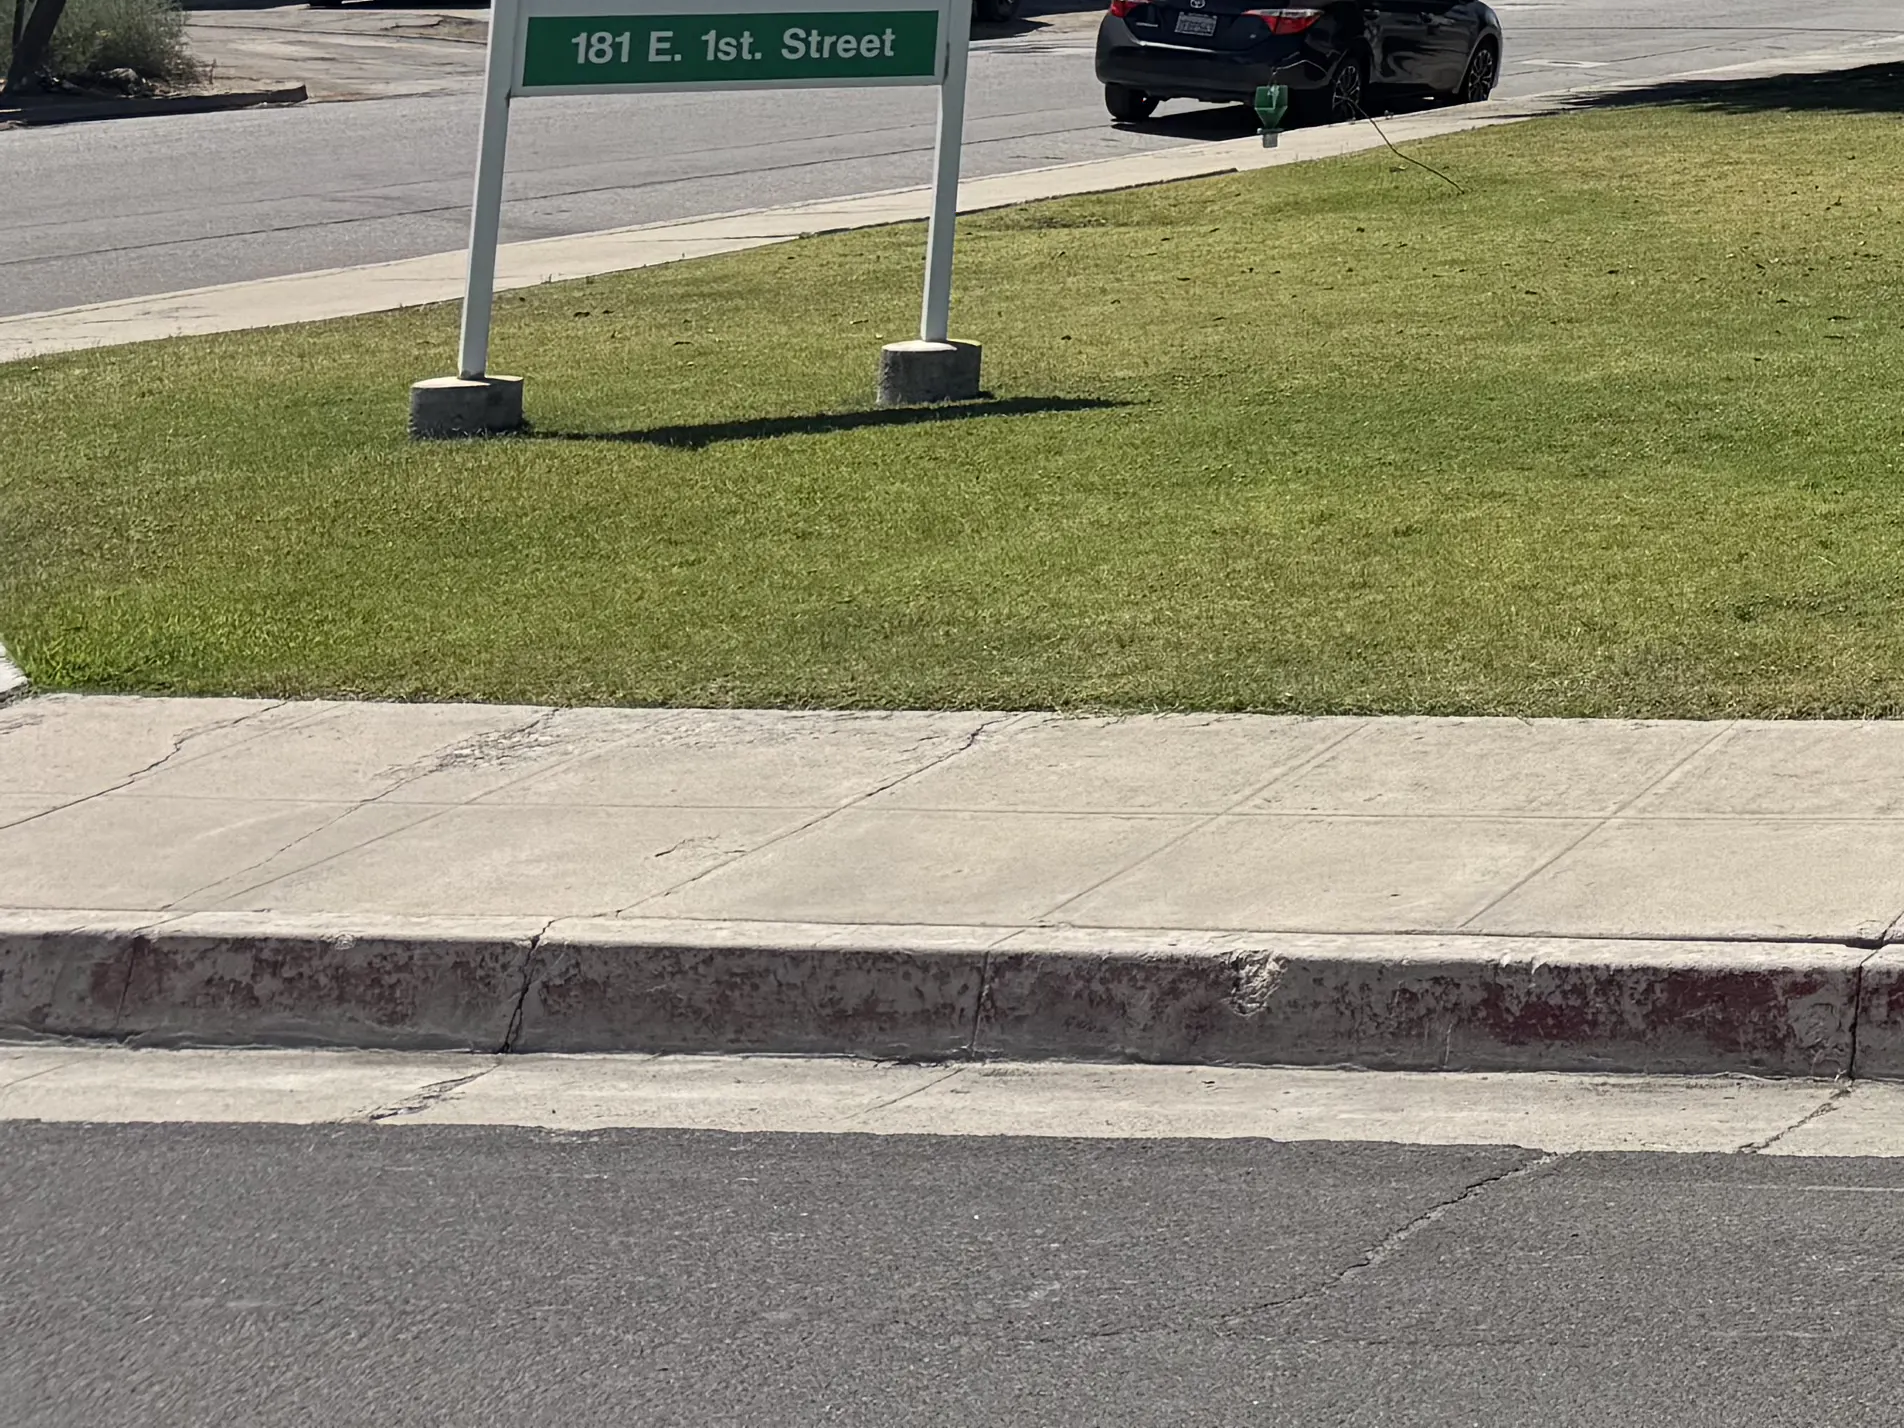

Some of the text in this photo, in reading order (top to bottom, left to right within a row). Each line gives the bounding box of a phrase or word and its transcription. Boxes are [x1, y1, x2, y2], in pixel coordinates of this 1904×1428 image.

[571, 27, 896, 64] 181 E. 1st. Street
